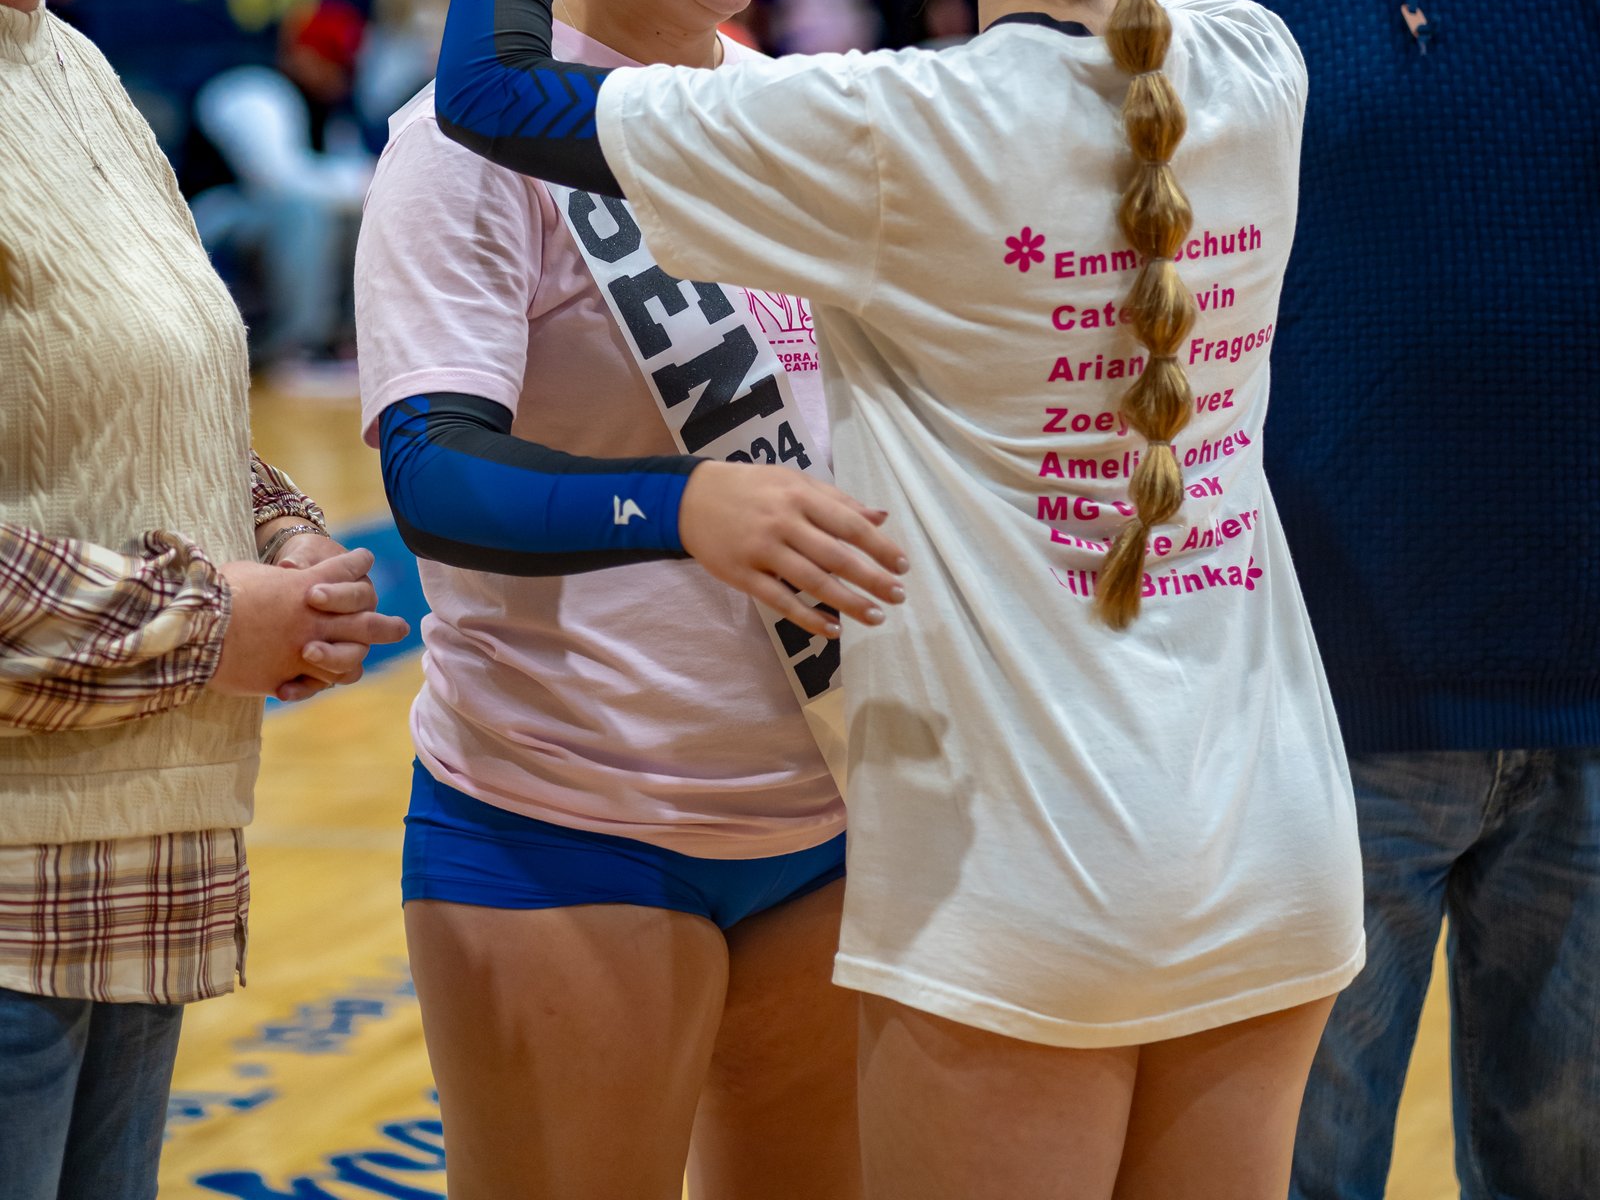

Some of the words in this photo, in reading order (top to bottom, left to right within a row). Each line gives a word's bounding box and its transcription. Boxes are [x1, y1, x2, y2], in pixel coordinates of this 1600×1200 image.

[1054, 249, 1149, 279] Emm
[1188, 323, 1273, 365] Fragoso
[1037, 496, 1100, 521] MG
